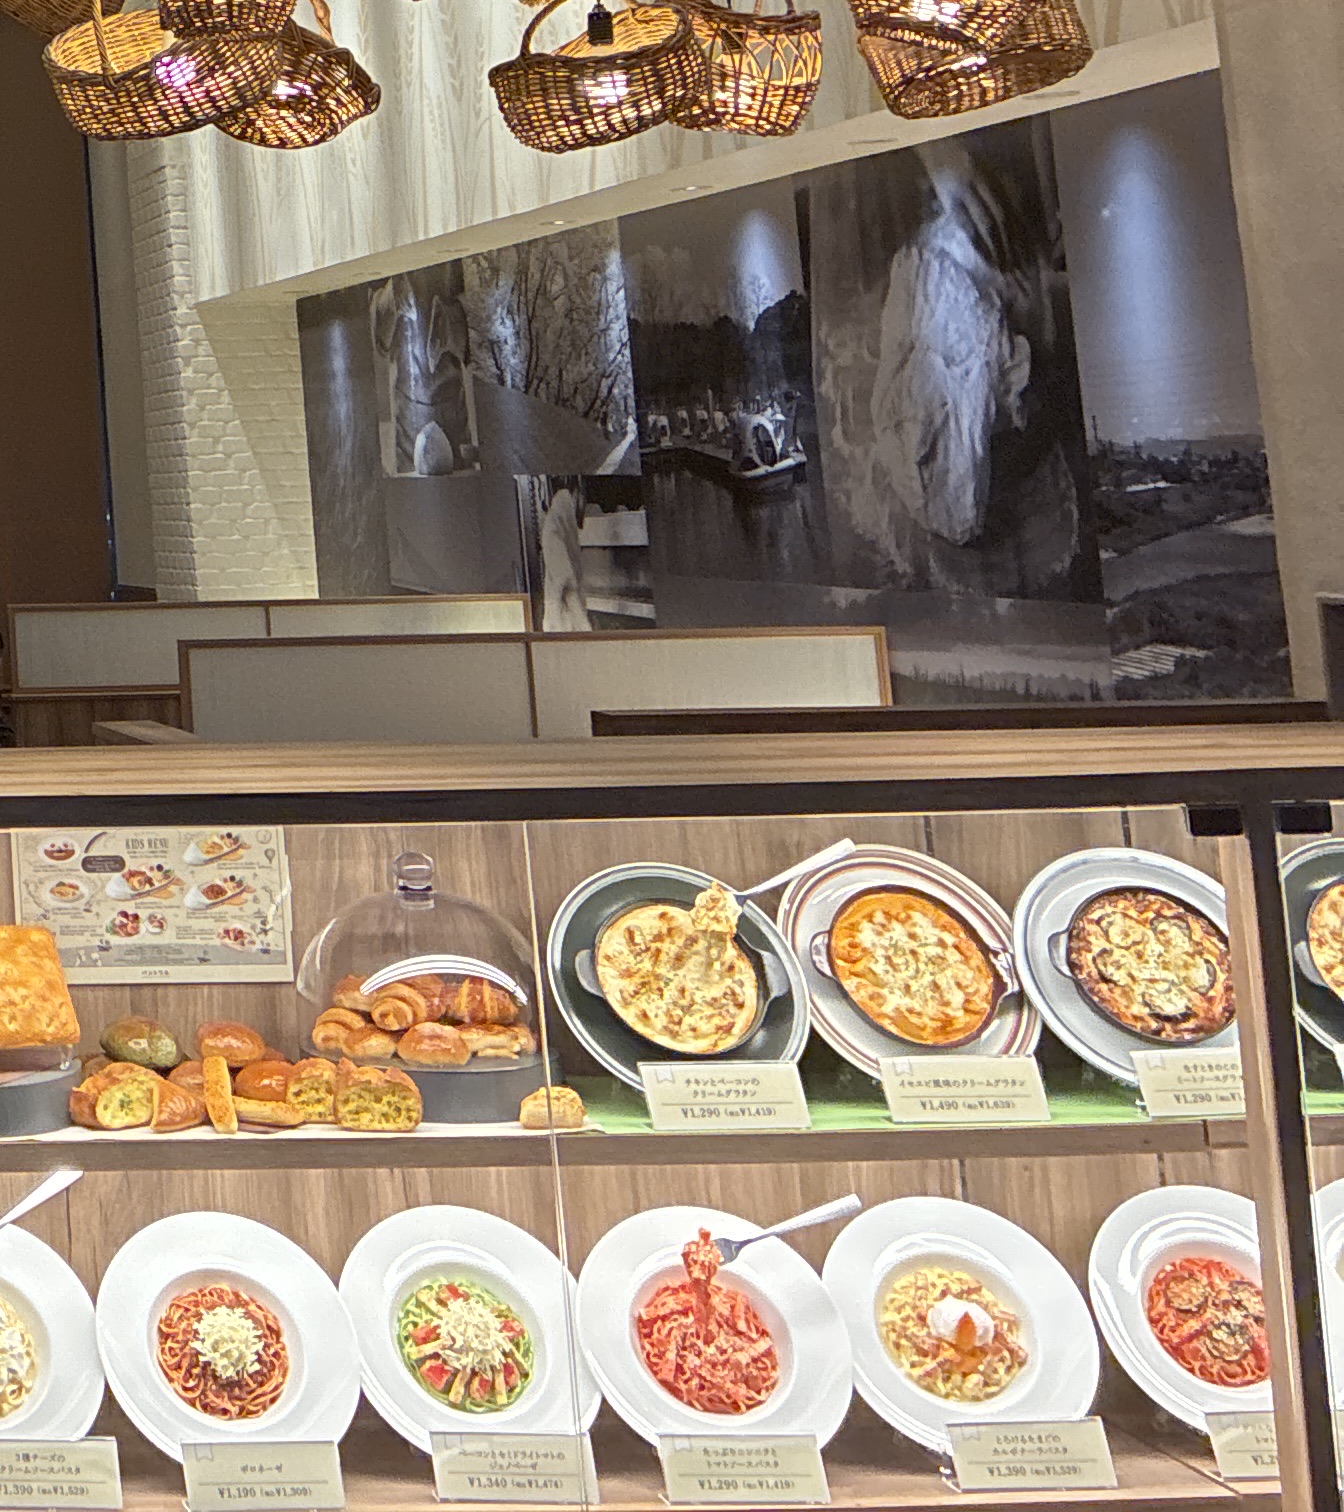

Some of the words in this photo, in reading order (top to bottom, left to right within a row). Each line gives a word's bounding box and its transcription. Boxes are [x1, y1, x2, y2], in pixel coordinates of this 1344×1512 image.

[684, 1077, 760, 1087] チキンとベーコンの
[898, 1079, 1027, 1089] イセエビ風味のクリームグラタン
[1176, 1075, 1243, 1085] ミートソースグラ
[692, 1089, 757, 1099] クリームグラタン
[1173, 1093, 1212, 1105] ¥1,290
[919, 1099, 958, 1112] ¥1,490
[681, 1107, 721, 1119] ¥1,290
[0, 1465, 81, 1476] クリームソースパスタ
[706, 1460, 780, 1470] トマトソースパスタ
[986, 1465, 1027, 1478] ¥1,390
[467, 1476, 507, 1489] ¥1,340
[698, 1479, 738, 1491] ¥1,290
[217, 1487, 257, 1499] ¥1,190
